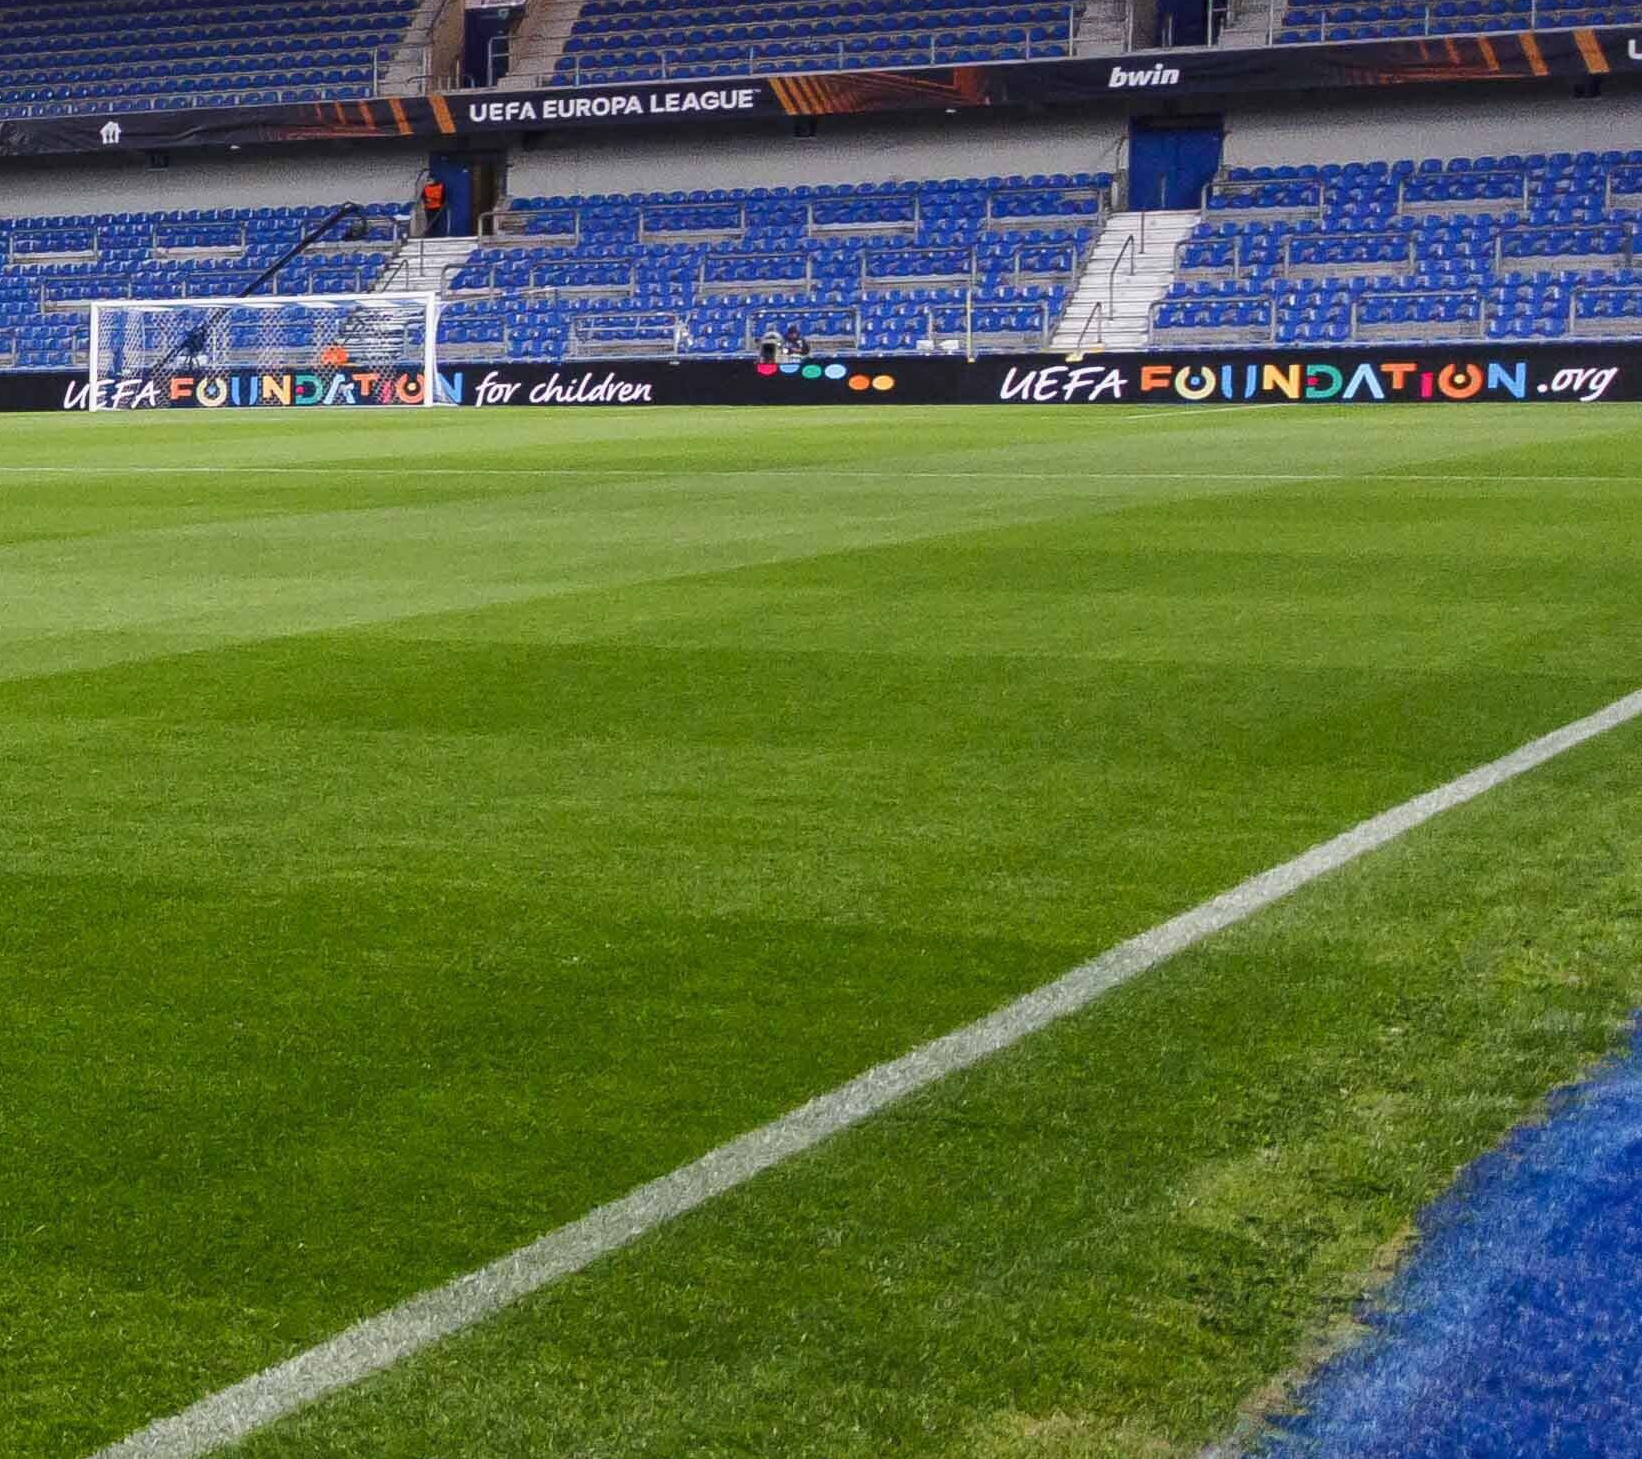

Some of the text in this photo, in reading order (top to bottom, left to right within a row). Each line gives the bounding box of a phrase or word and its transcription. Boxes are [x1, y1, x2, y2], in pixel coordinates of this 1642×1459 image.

[1108, 63, 1180, 87] bwin
[469, 90, 755, 122] UEFA EUROPA LEAGUE
[63, 379, 162, 409] UEFA
[475, 371, 522, 408] for
[529, 372, 652, 404] children
[1000, 362, 1619, 403] UEFA FOUNDATION .org
